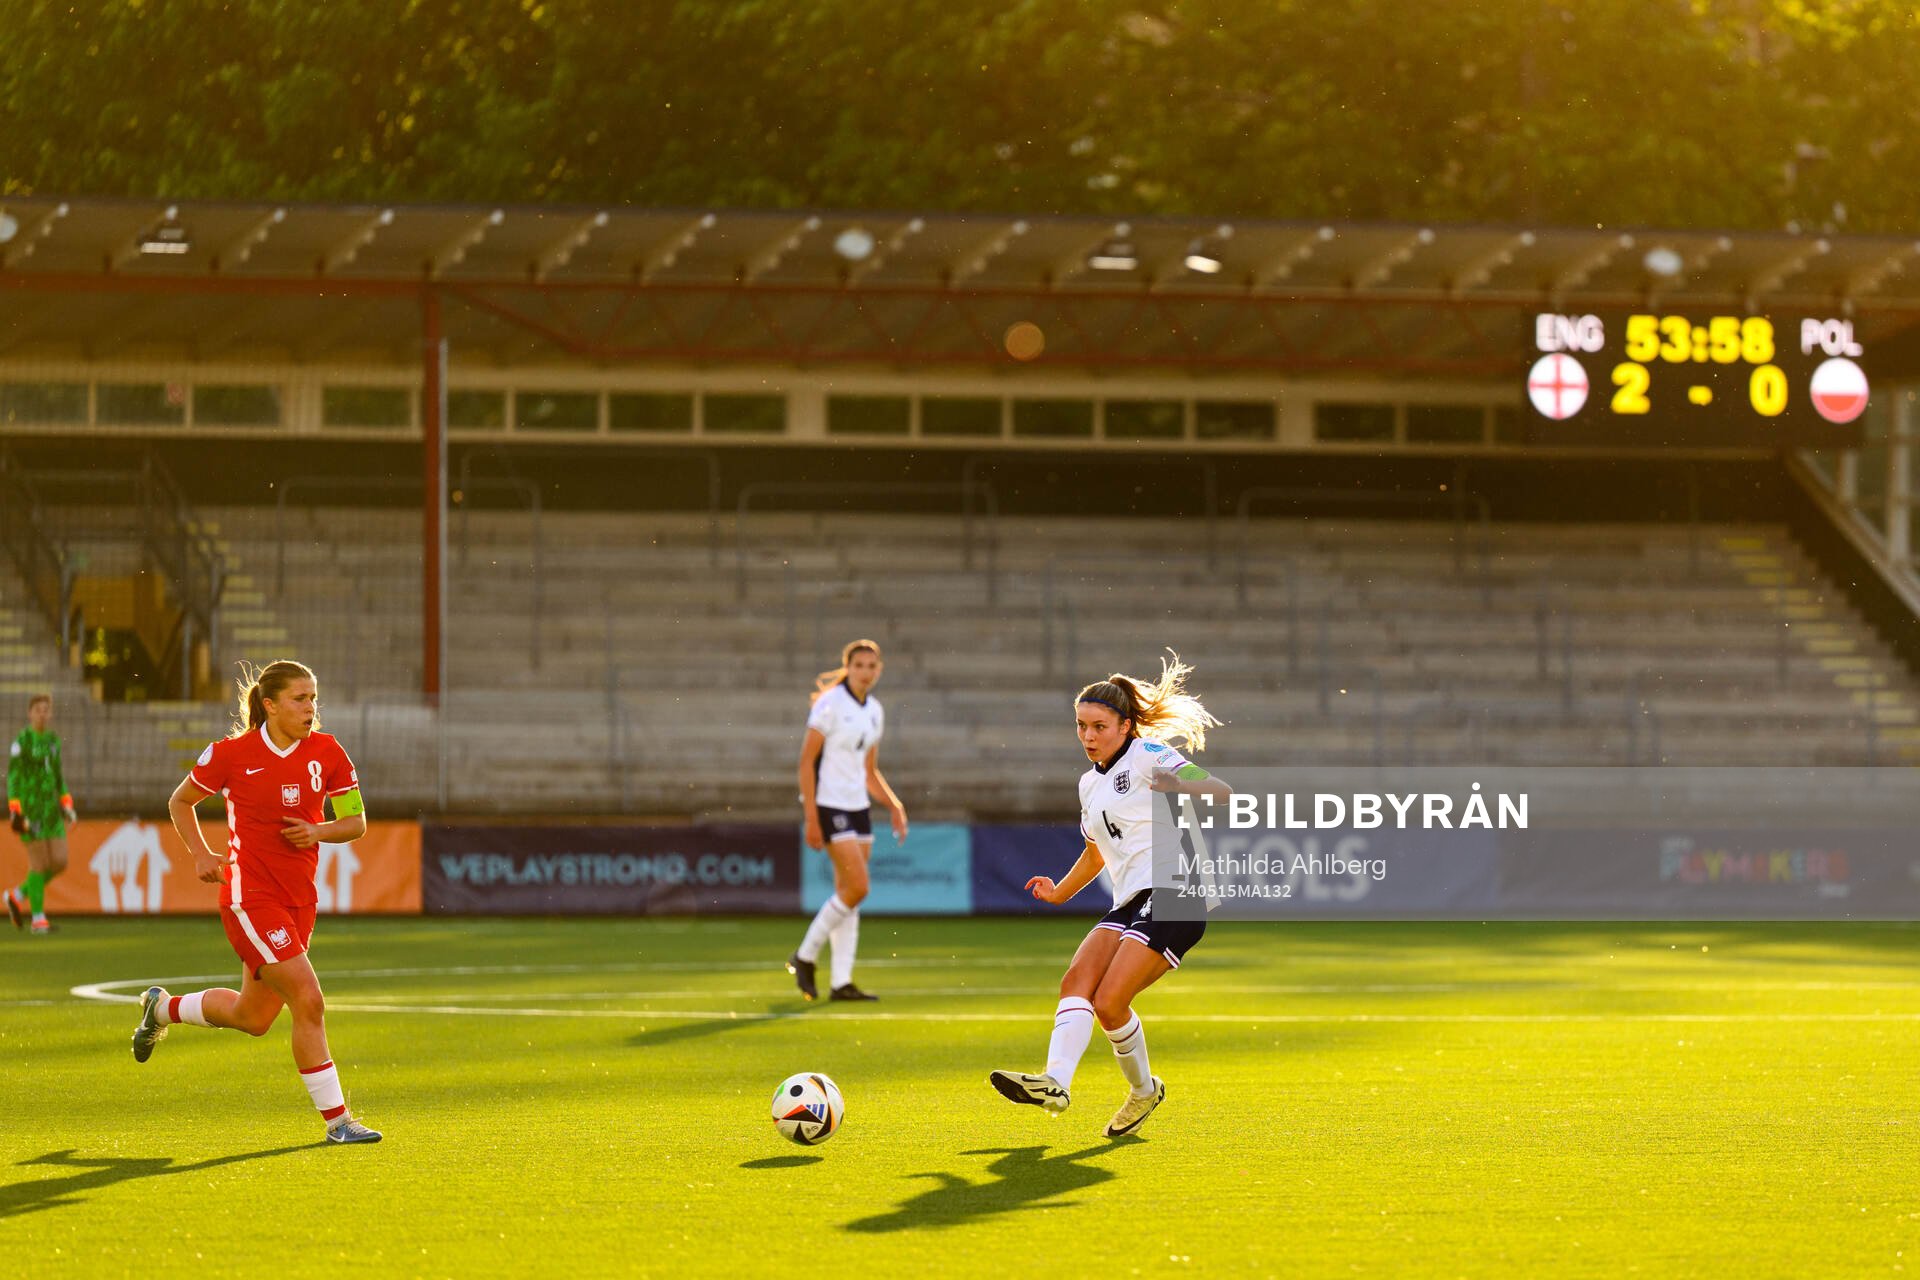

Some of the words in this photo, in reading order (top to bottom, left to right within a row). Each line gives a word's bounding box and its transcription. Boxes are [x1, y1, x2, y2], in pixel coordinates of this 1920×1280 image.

[1535, 313, 1605, 352] ENG
[1625, 314, 1775, 364] 53:58
[1801, 317, 1864, 357] POL
[1610, 362, 1651, 415] 2
[1749, 364, 1789, 417] 0
[307, 760, 323, 793] 8
[1102, 810, 1123, 840] 4
[438, 853, 775, 884] WEPLAYSTRONG.COM
